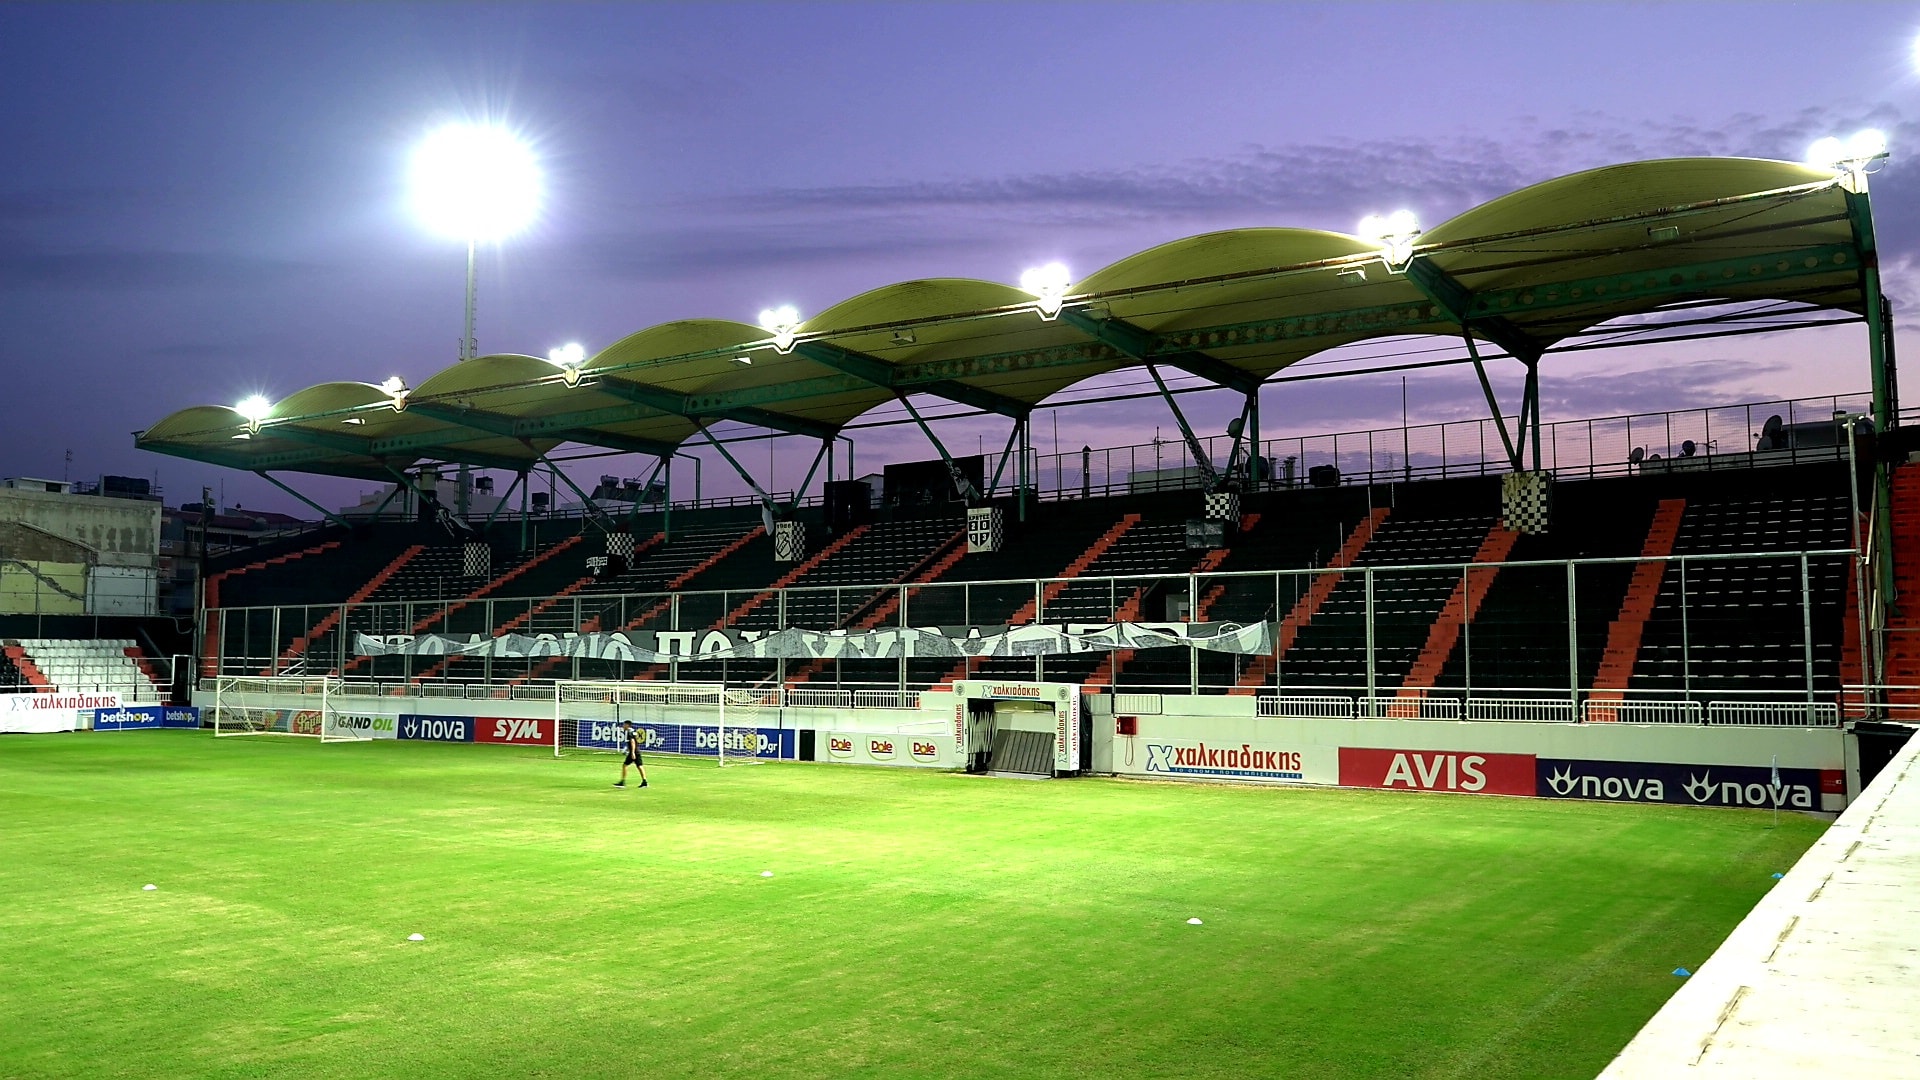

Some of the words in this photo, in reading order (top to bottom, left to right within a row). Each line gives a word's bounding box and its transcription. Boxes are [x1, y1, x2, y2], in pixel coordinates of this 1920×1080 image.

[32, 694, 116, 709] χαλκιαδακης
[372, 718, 393, 731] OIL
[421, 719, 465, 740] nova
[493, 719, 542, 741] SYM
[831, 738, 852, 749] Dole
[871, 740, 893, 751] Dole
[913, 742, 935, 753] Dole
[1174, 743, 1301, 771] χαλκιαδακης
[1382, 753, 1487, 791] AVIS
[1582, 775, 1664, 800] nova
[1722, 781, 1812, 808] nova
